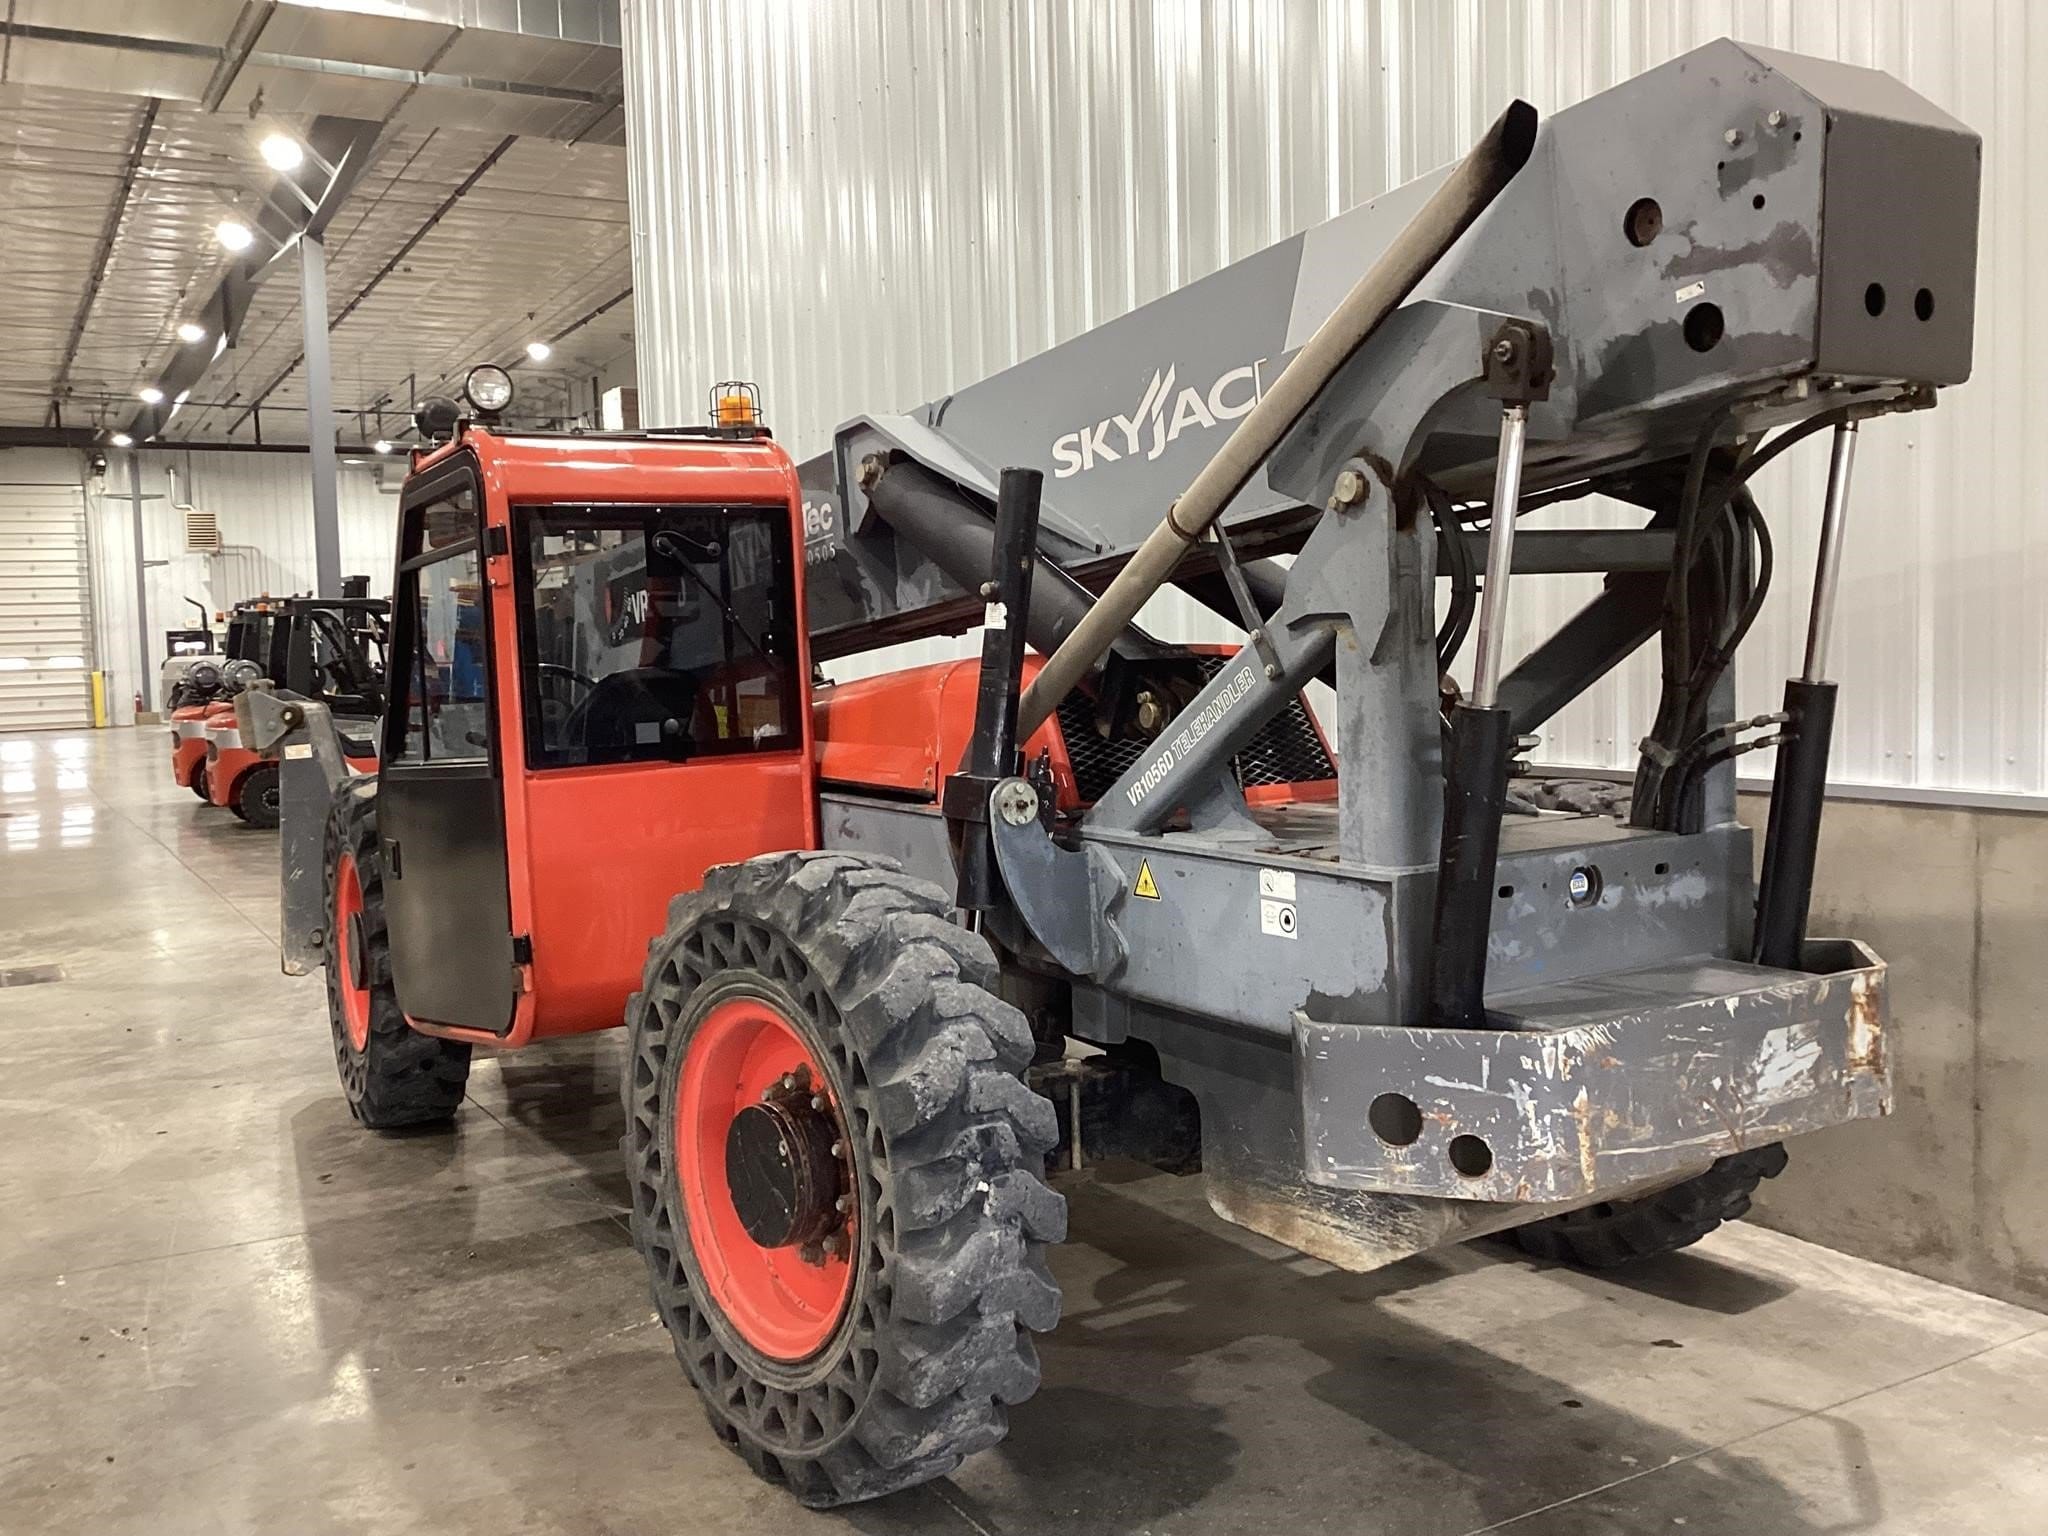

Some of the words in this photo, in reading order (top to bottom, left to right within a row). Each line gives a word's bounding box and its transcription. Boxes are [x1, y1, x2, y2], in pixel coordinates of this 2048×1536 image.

[1052, 358, 1267, 478] SKYJAC
[1125, 750, 1174, 807] VR1056D
[1172, 666, 1256, 760] TELEHANDLER
